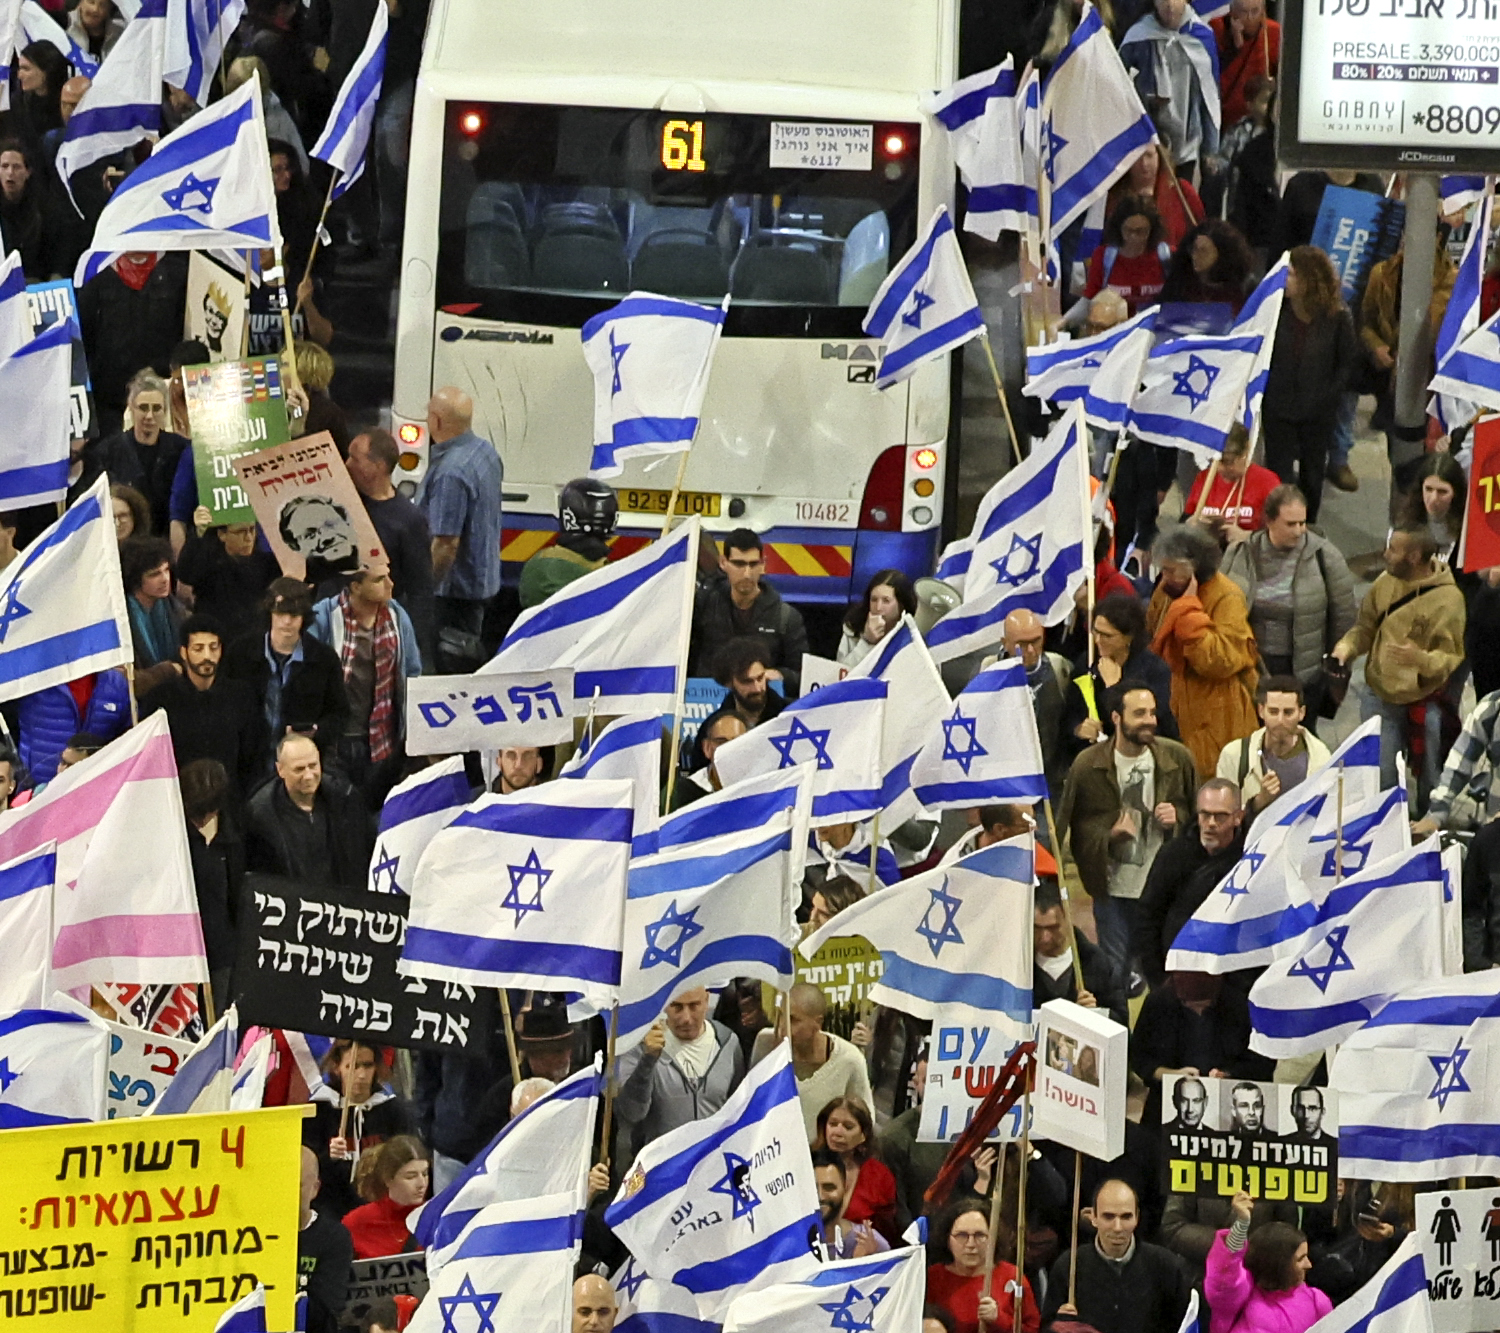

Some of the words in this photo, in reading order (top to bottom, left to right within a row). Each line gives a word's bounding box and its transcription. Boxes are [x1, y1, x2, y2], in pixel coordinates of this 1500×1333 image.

[1332, 41, 1410, 62] PRESALE
[1340, 64, 1369, 79] 80%
[1375, 65, 1404, 80] 20%
[1407, 67, 1443, 81] תשלום
[662, 120, 707, 172] 61
[794, 499, 850, 523] 10482
[253, 891, 287, 927] כי
[258, 936, 373, 985] שינתה
[320, 990, 394, 1031] פניה
[411, 1006, 471, 1048] את
[1044, 1077, 1099, 1116] בושה!
[56, 1137, 202, 1180] רשויות
[220, 1125, 246, 1169] 4
[1169, 1131, 1243, 1161] למינוי
[1250, 1139, 1329, 1168] הועדה
[1169, 1158, 1329, 1204] שפוטים
[19, 1183, 220, 1230] עצמאיות:
